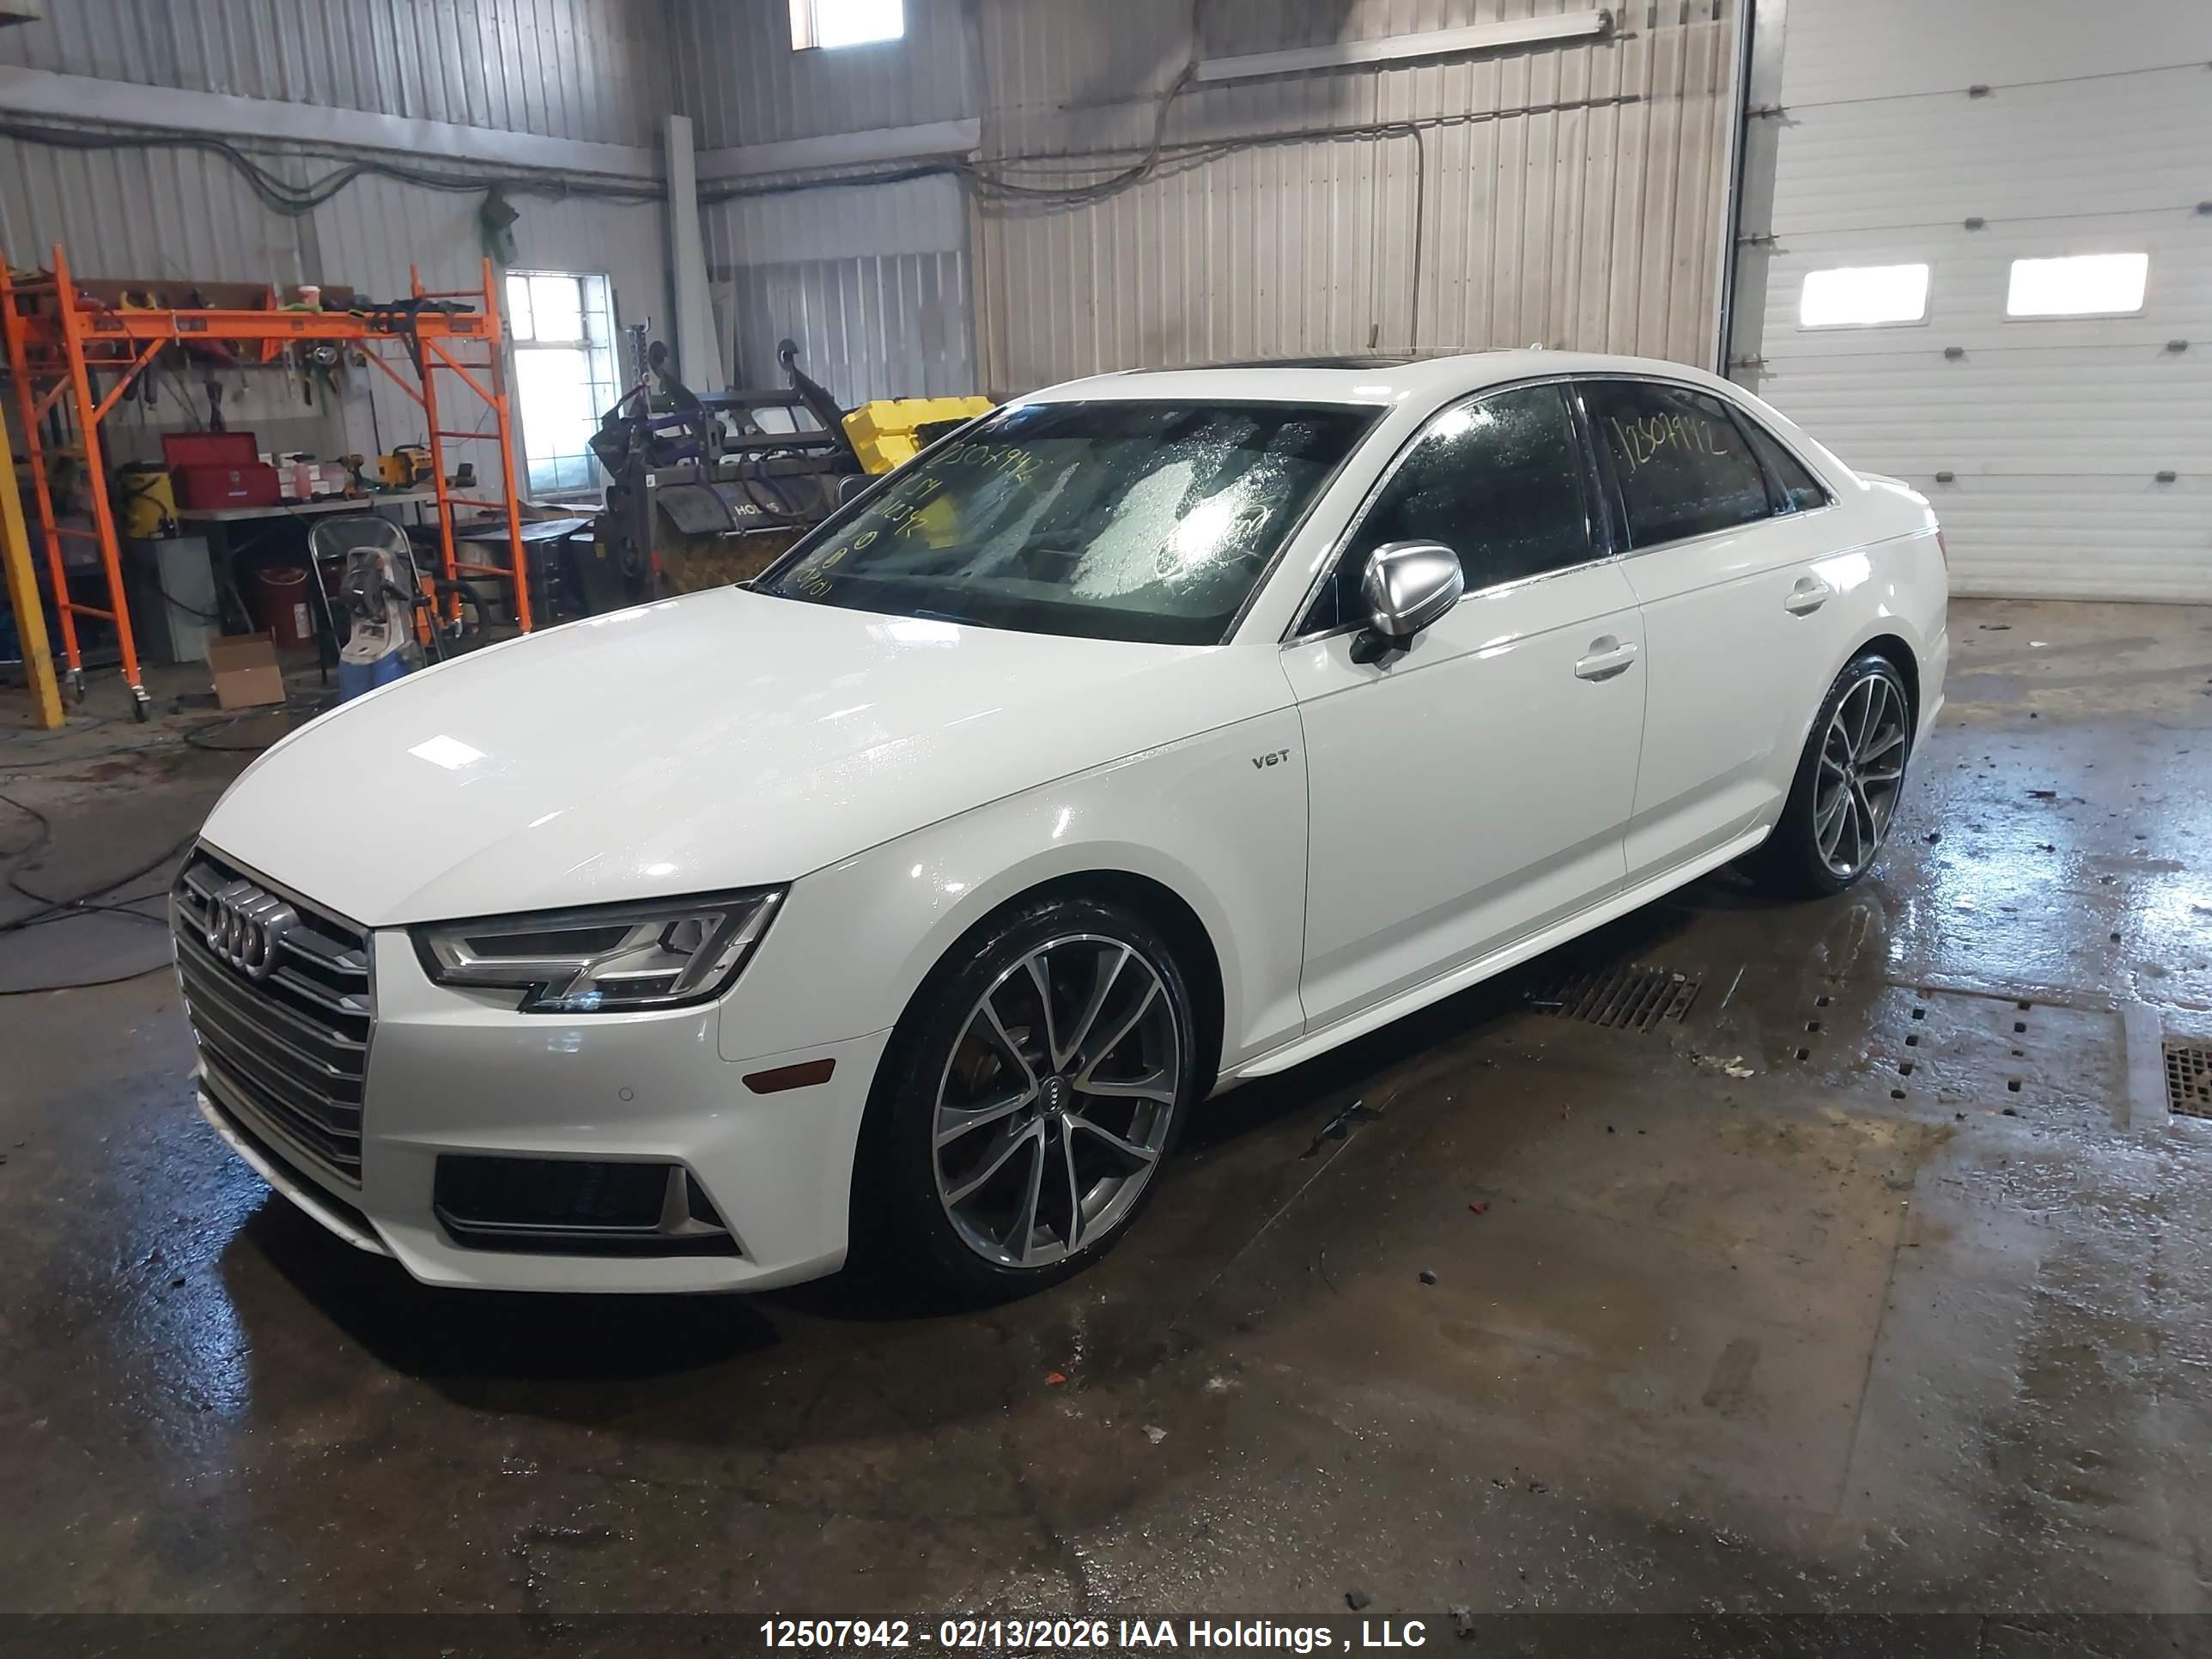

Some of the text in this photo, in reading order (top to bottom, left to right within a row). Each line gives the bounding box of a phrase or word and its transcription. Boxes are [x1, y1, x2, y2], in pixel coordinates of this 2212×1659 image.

[1611, 412, 1728, 471] 12507942
[734, 502, 780, 515] HOLS
[1252, 749, 1290, 769] V6T
